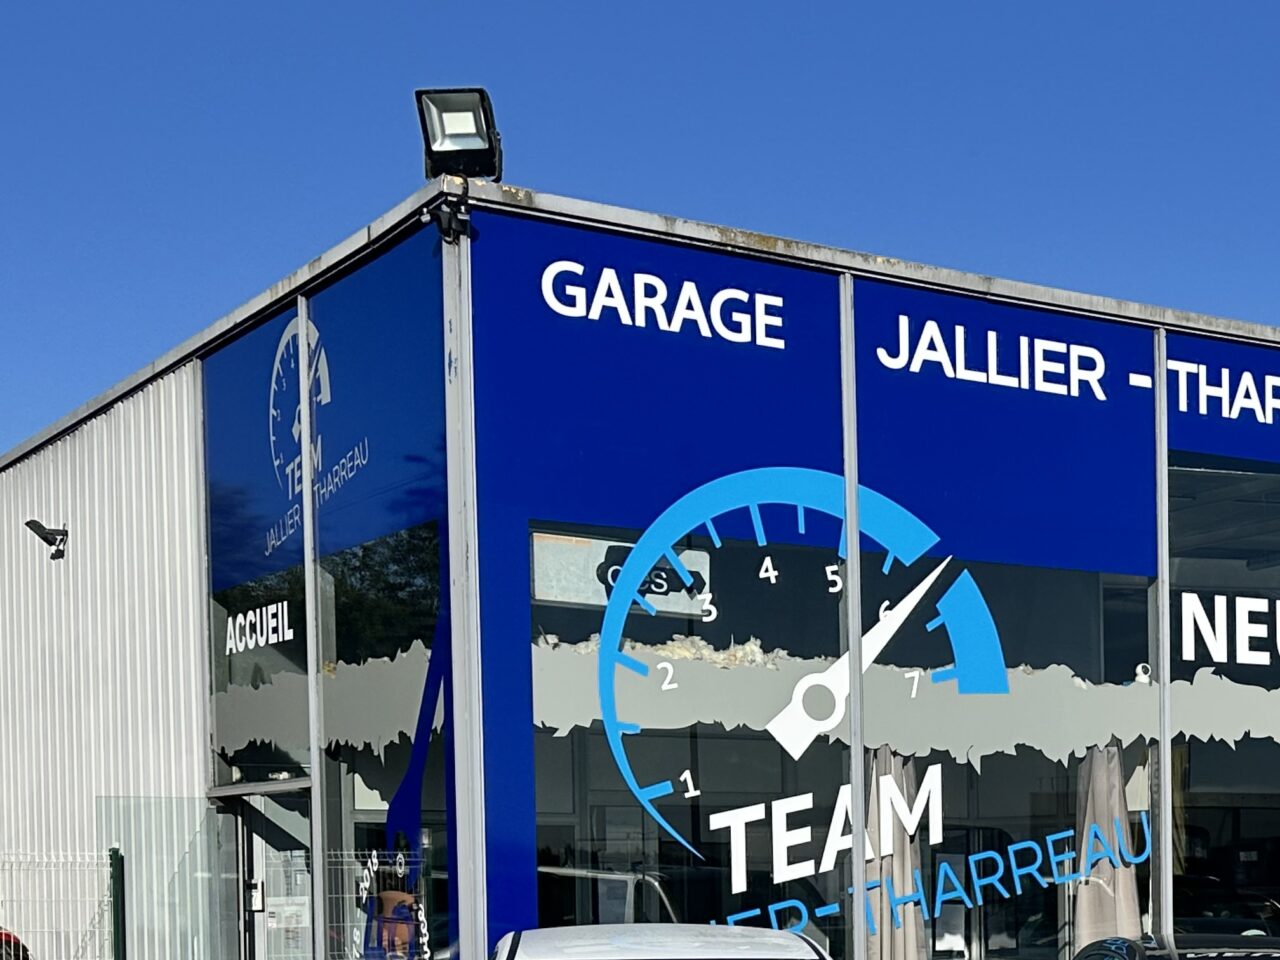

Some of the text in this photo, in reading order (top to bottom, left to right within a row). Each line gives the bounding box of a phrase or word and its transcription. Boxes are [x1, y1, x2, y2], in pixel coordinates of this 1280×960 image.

[541, 260, 786, 349] GARAGE
[876, 315, 1107, 401] JALLIER
[285, 435, 323, 500] TEM
[264, 436, 370, 556] JALLIER THARREAU
[758, 557, 778, 585] 4
[824, 565, 843, 593] 5
[696, 592, 718, 622] 3
[225, 600, 294, 656] ACCUEIL
[656, 662, 679, 690] 2
[904, 670, 920, 698] 7
[678, 770, 700, 798] 1
[708, 763, 945, 895] TEAM
[359, 850, 379, 903] 2018
